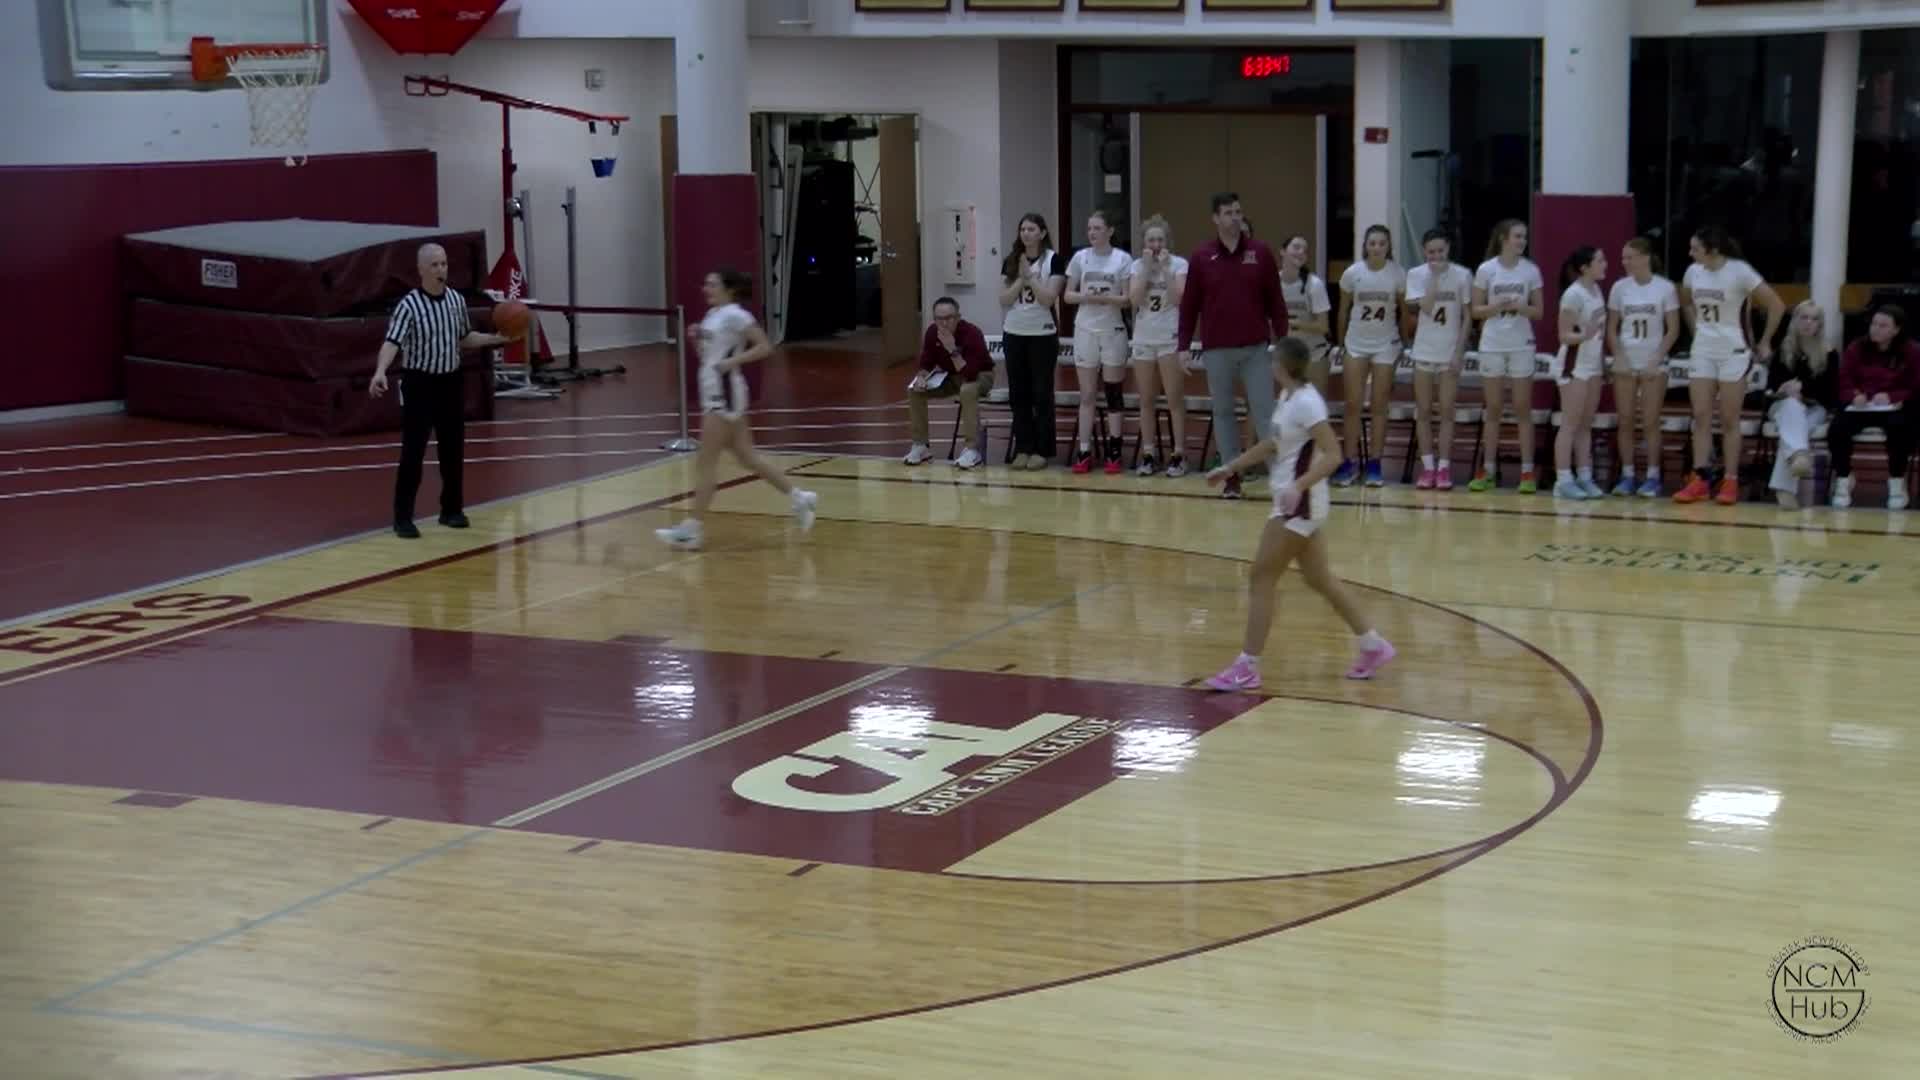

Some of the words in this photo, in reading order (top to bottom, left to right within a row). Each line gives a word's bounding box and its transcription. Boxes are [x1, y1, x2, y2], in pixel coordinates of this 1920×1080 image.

[1149, 295, 1162, 312] 3
[1360, 305, 1386, 322] 24
[1433, 307, 1447, 325] 4
[1699, 304, 1720, 323] 21
[1631, 319, 1648, 339] 11
